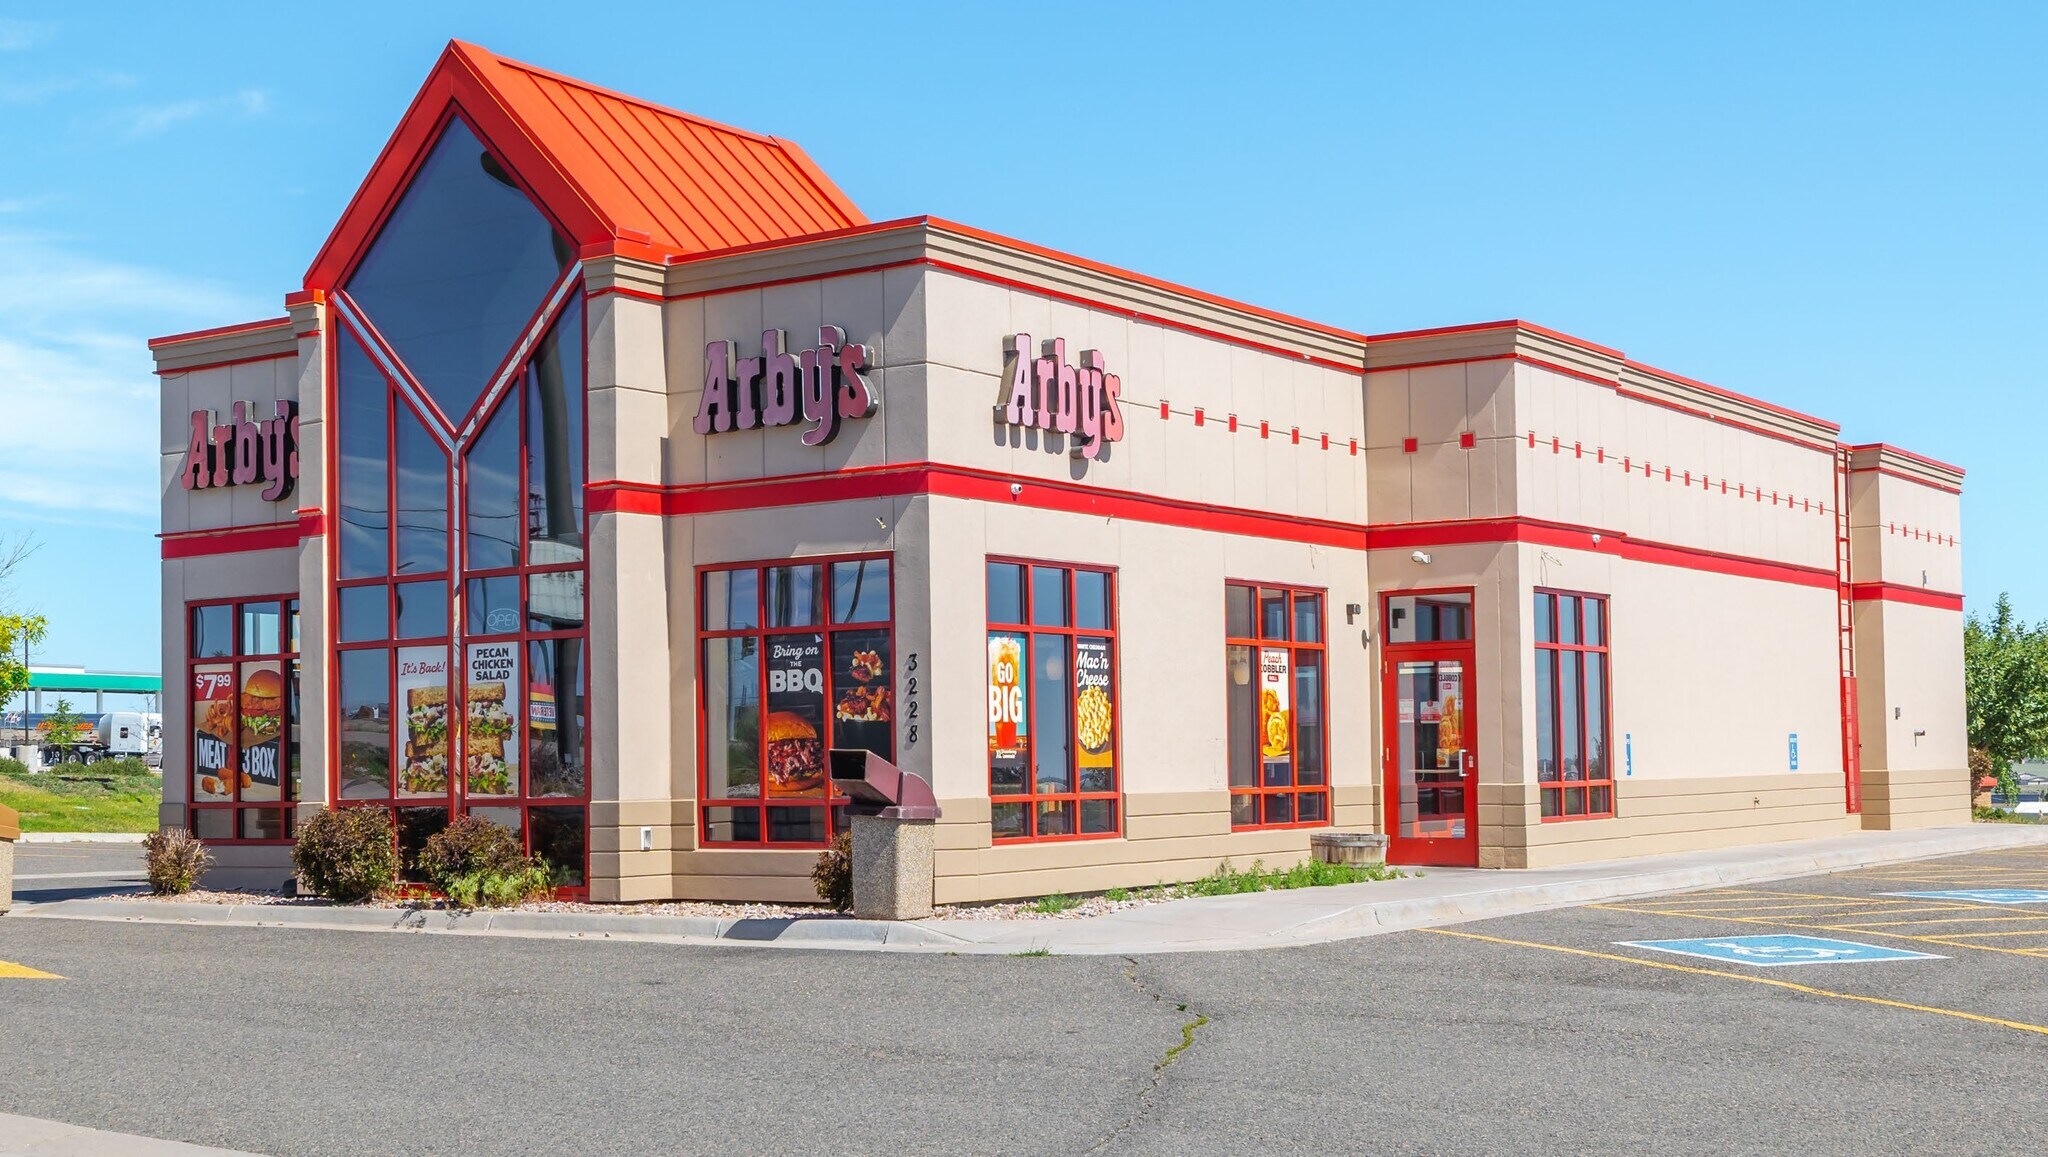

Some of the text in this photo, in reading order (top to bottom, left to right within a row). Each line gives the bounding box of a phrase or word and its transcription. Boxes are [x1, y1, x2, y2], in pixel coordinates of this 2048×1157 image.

[693, 325, 876, 447] Arby's
[1003, 333, 1124, 460] Arby's
[476, 648, 509, 659] PECAN
[773, 645, 819, 660] Bring on
[401, 661, 446, 676] It's Back!
[472, 658, 514, 670] CHICKEN
[997, 661, 1014, 684] GO
[475, 669, 510, 681] SALAD
[770, 668, 823, 694] BBQ
[1076, 669, 1109, 687] Cheese
[989, 685, 1023, 723] BIG
[199, 738, 276, 779] MEAT 3 BOX
